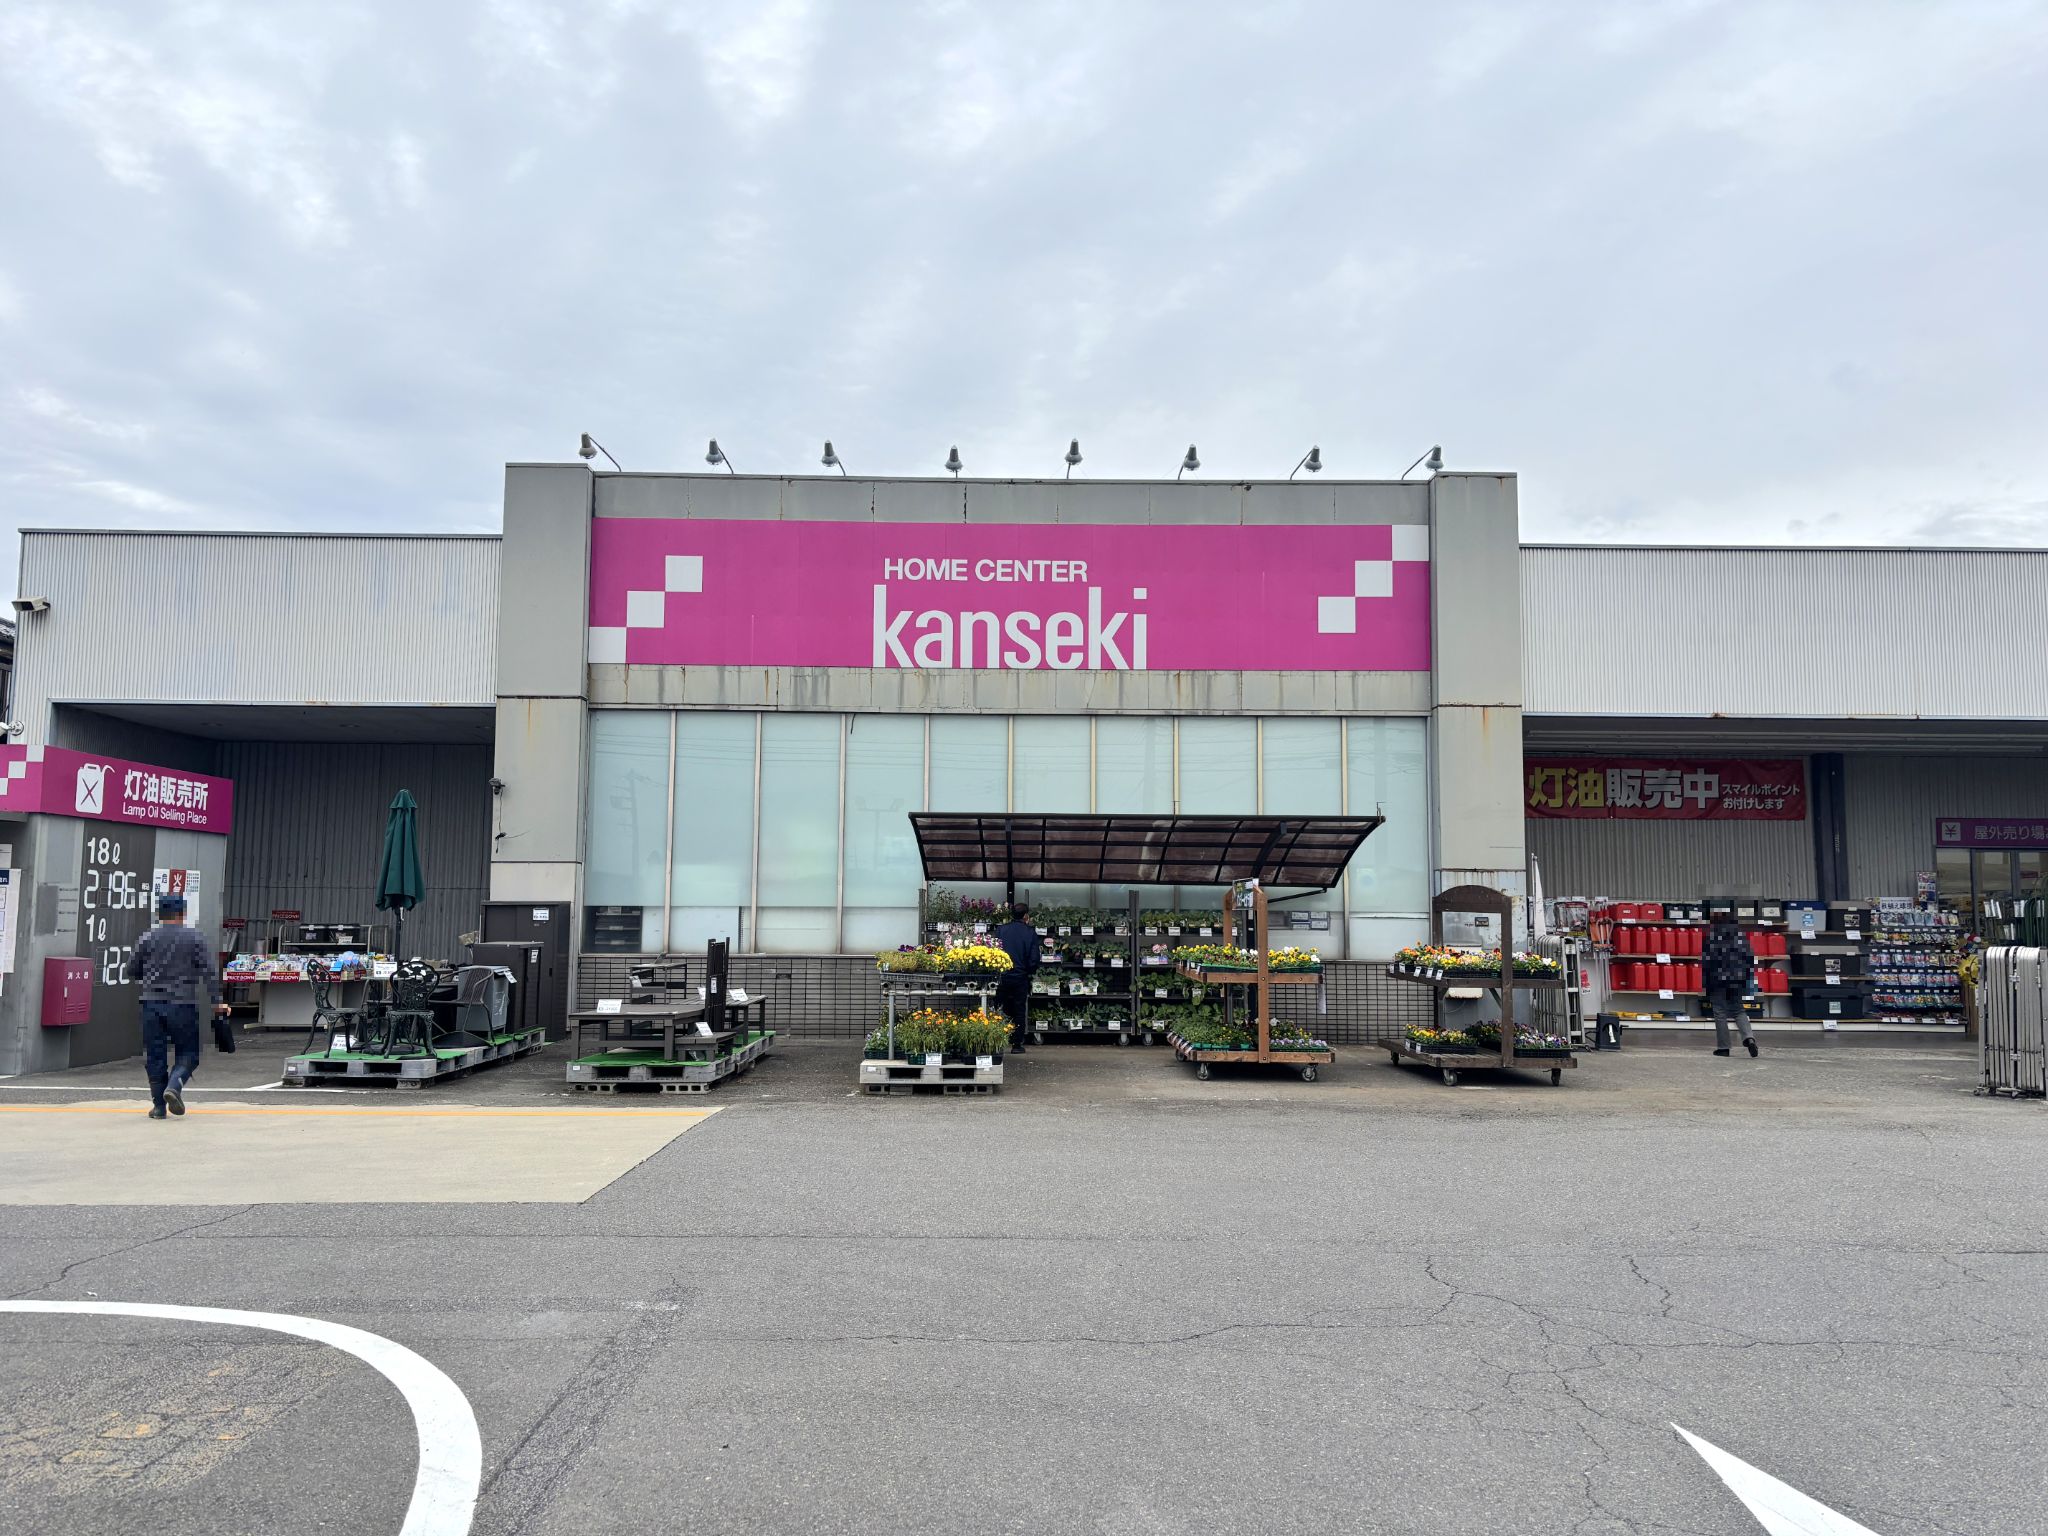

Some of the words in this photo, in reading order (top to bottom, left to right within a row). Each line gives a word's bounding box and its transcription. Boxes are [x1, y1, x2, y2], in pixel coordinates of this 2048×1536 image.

[884, 557, 967, 582] HOME
[975, 558, 1088, 583] CENTER
[873, 584, 1148, 671] kanseki
[123, 768, 209, 811] 灯油販売所
[1527, 767, 1720, 809] 灯油販売中
[1722, 783, 1800, 796] スマイルポイント
[1723, 797, 1785, 810] お付けします
[122, 801, 146, 819] Lamp
[147, 805, 159, 818] Oil
[160, 807, 186, 825] Selling
[187, 811, 207, 825] Place
[102, 946, 132, 986] 122
